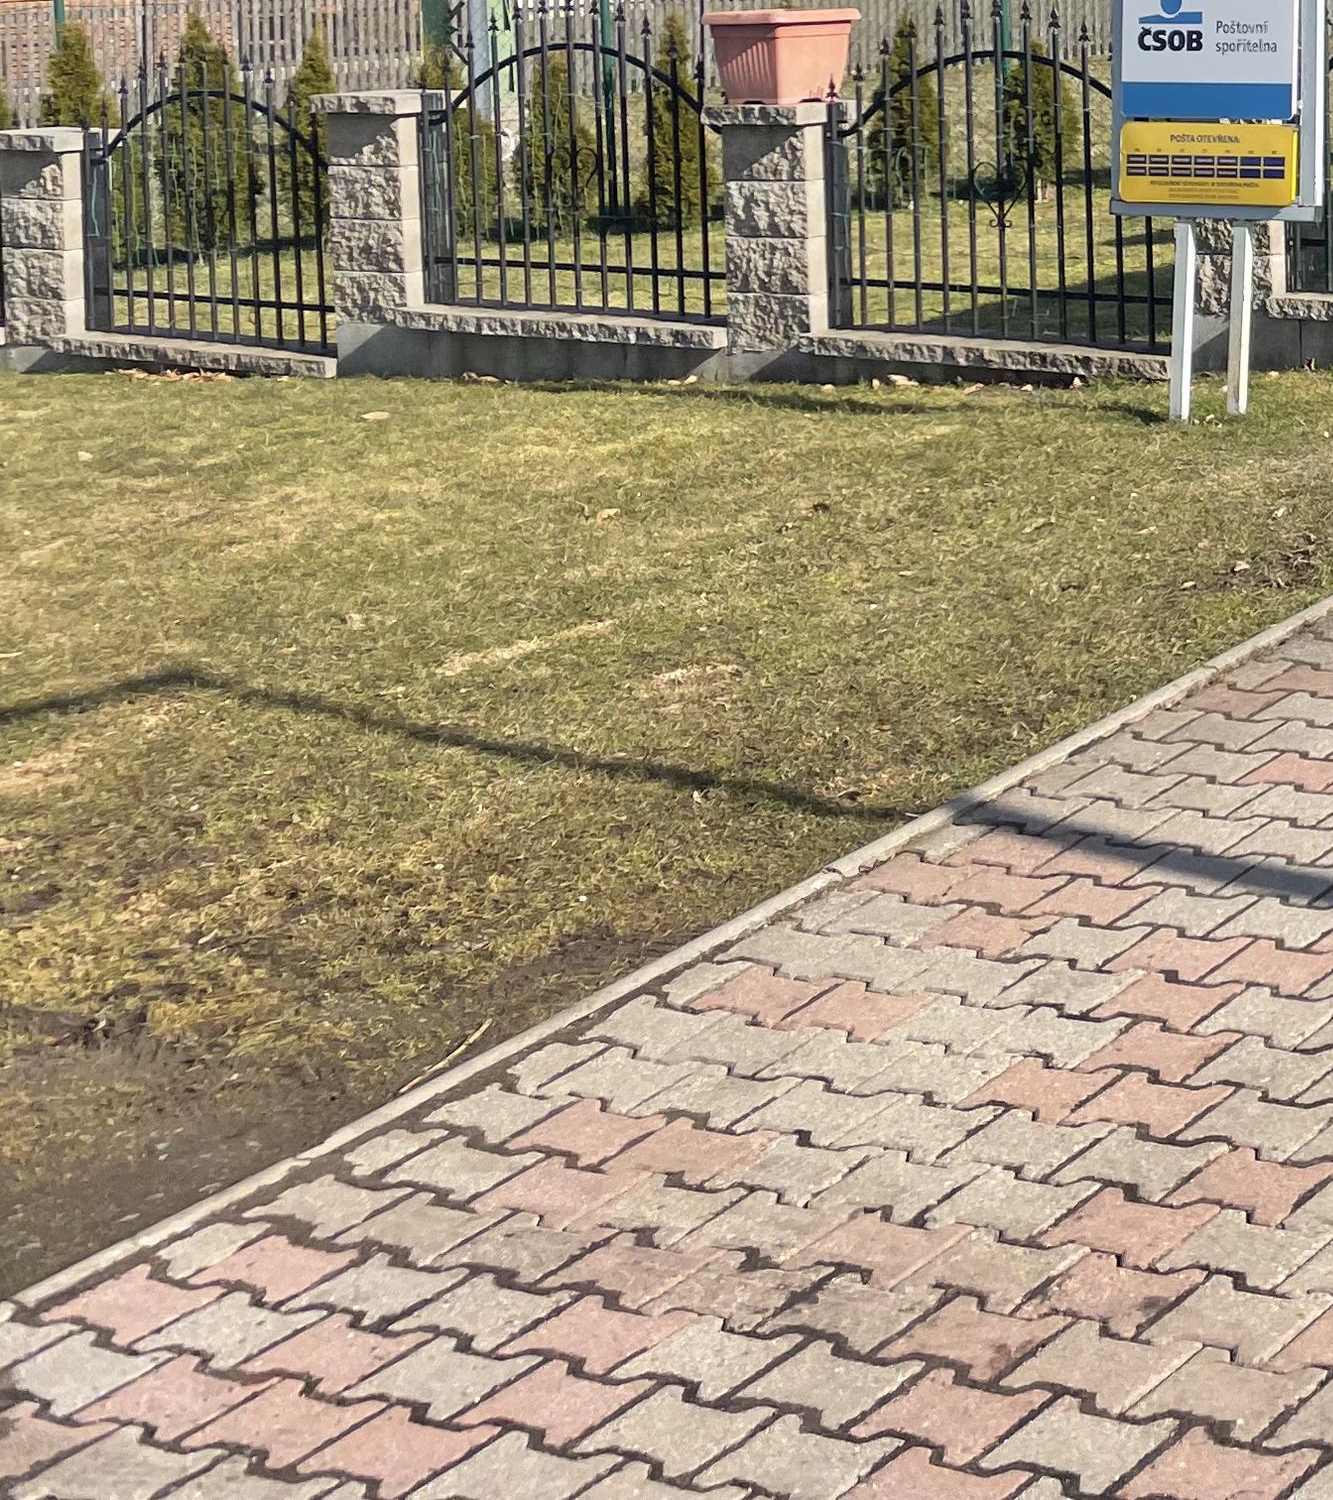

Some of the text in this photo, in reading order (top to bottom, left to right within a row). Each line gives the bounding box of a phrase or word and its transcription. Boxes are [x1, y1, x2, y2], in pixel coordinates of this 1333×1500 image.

[1215, 20, 1269, 34] Poštovní
[1138, 26, 1203, 51] ČSOB
[1215, 38, 1278, 55] spořitelna
